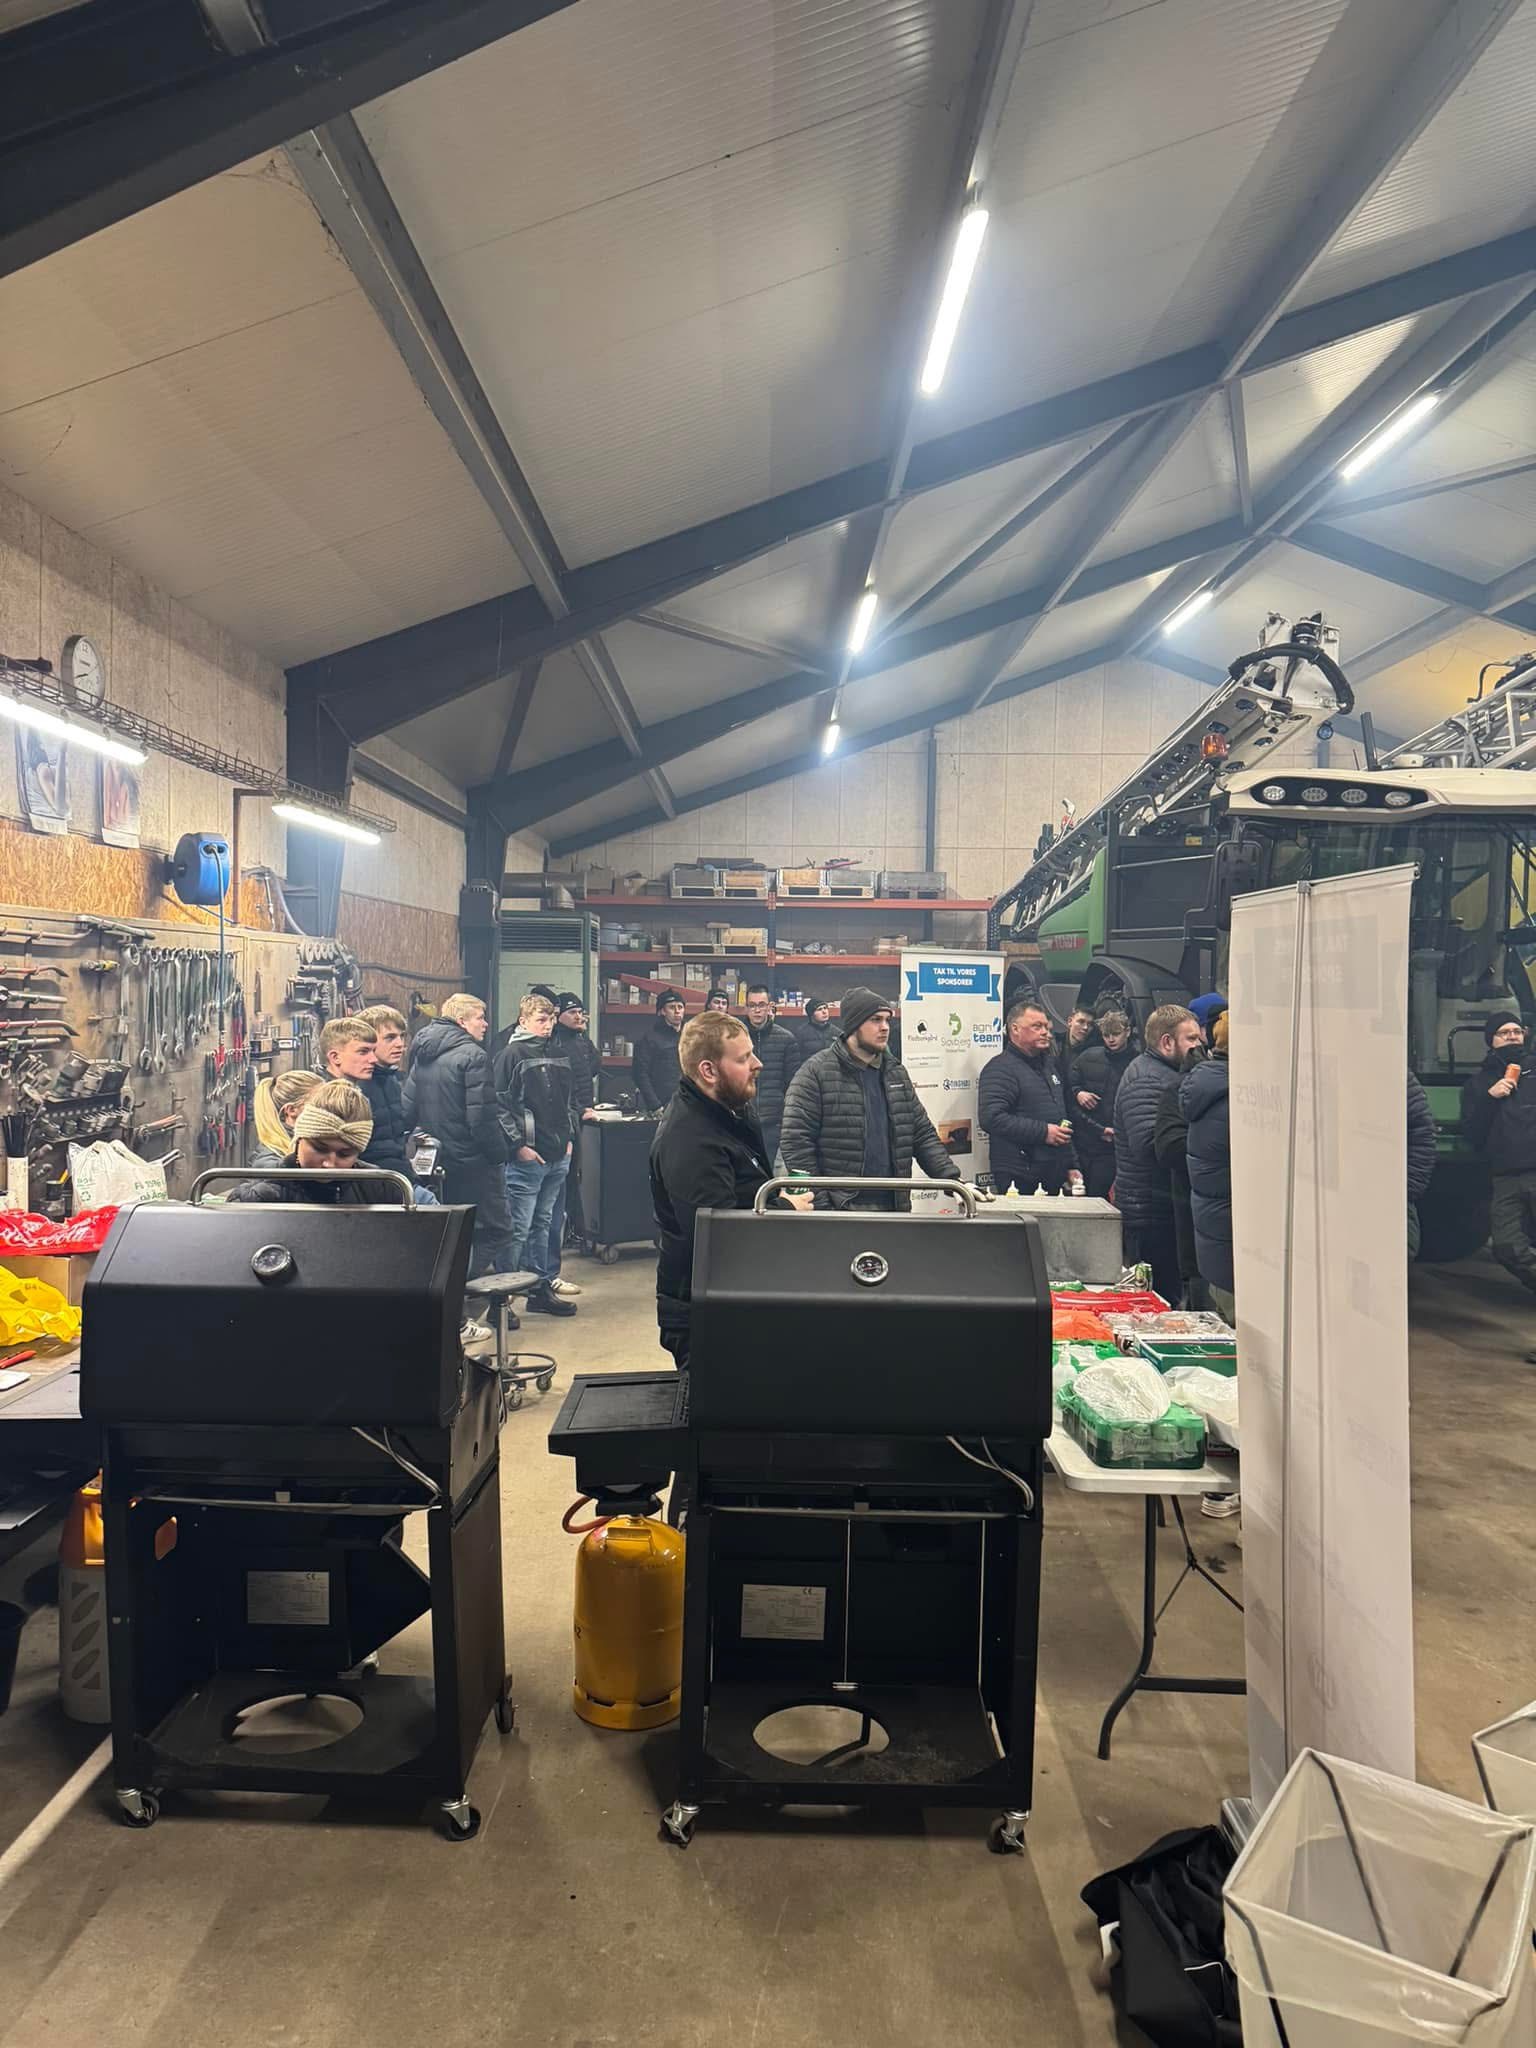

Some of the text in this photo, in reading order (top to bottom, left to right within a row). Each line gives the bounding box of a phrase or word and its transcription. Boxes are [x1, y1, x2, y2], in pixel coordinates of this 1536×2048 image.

[933, 967, 977, 976] TAK TIL VORES
[937, 978, 973, 986] SPONSORER
[973, 1032, 1001, 1043] team
